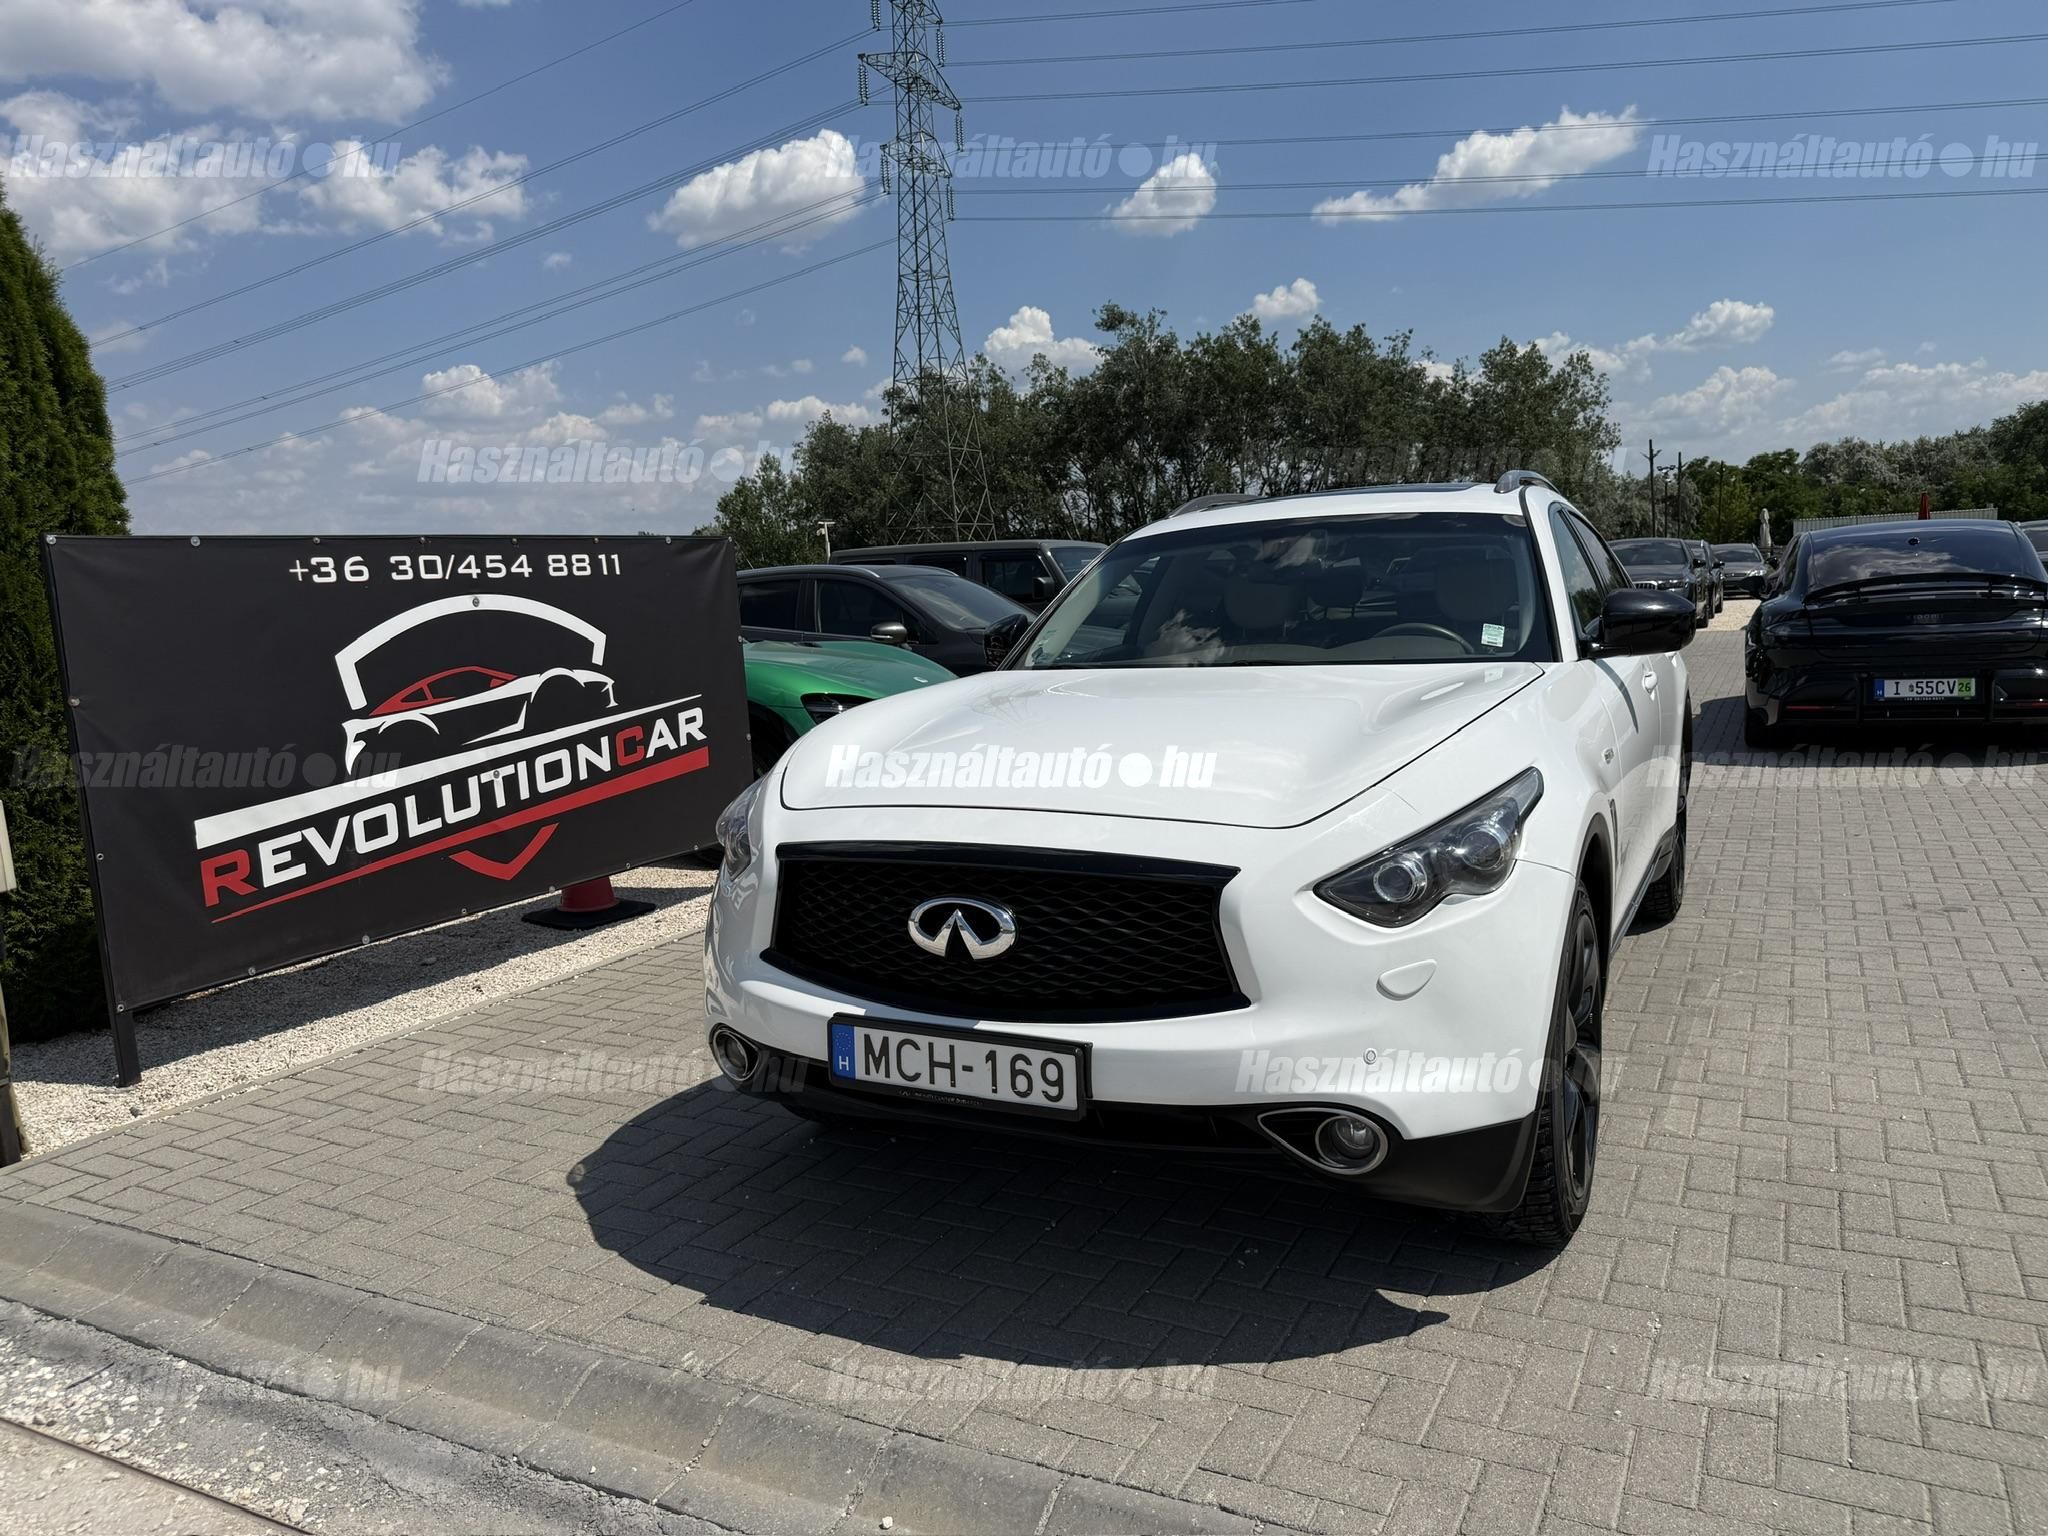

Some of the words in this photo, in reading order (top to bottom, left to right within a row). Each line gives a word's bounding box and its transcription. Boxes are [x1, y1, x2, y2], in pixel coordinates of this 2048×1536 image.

[289, 556, 370, 583] +36
[389, 554, 533, 580] 30/454
[547, 553, 622, 577] 8811
[1958, 683, 1971, 693] 26
[863, 1033, 1065, 1103] MCH-169
